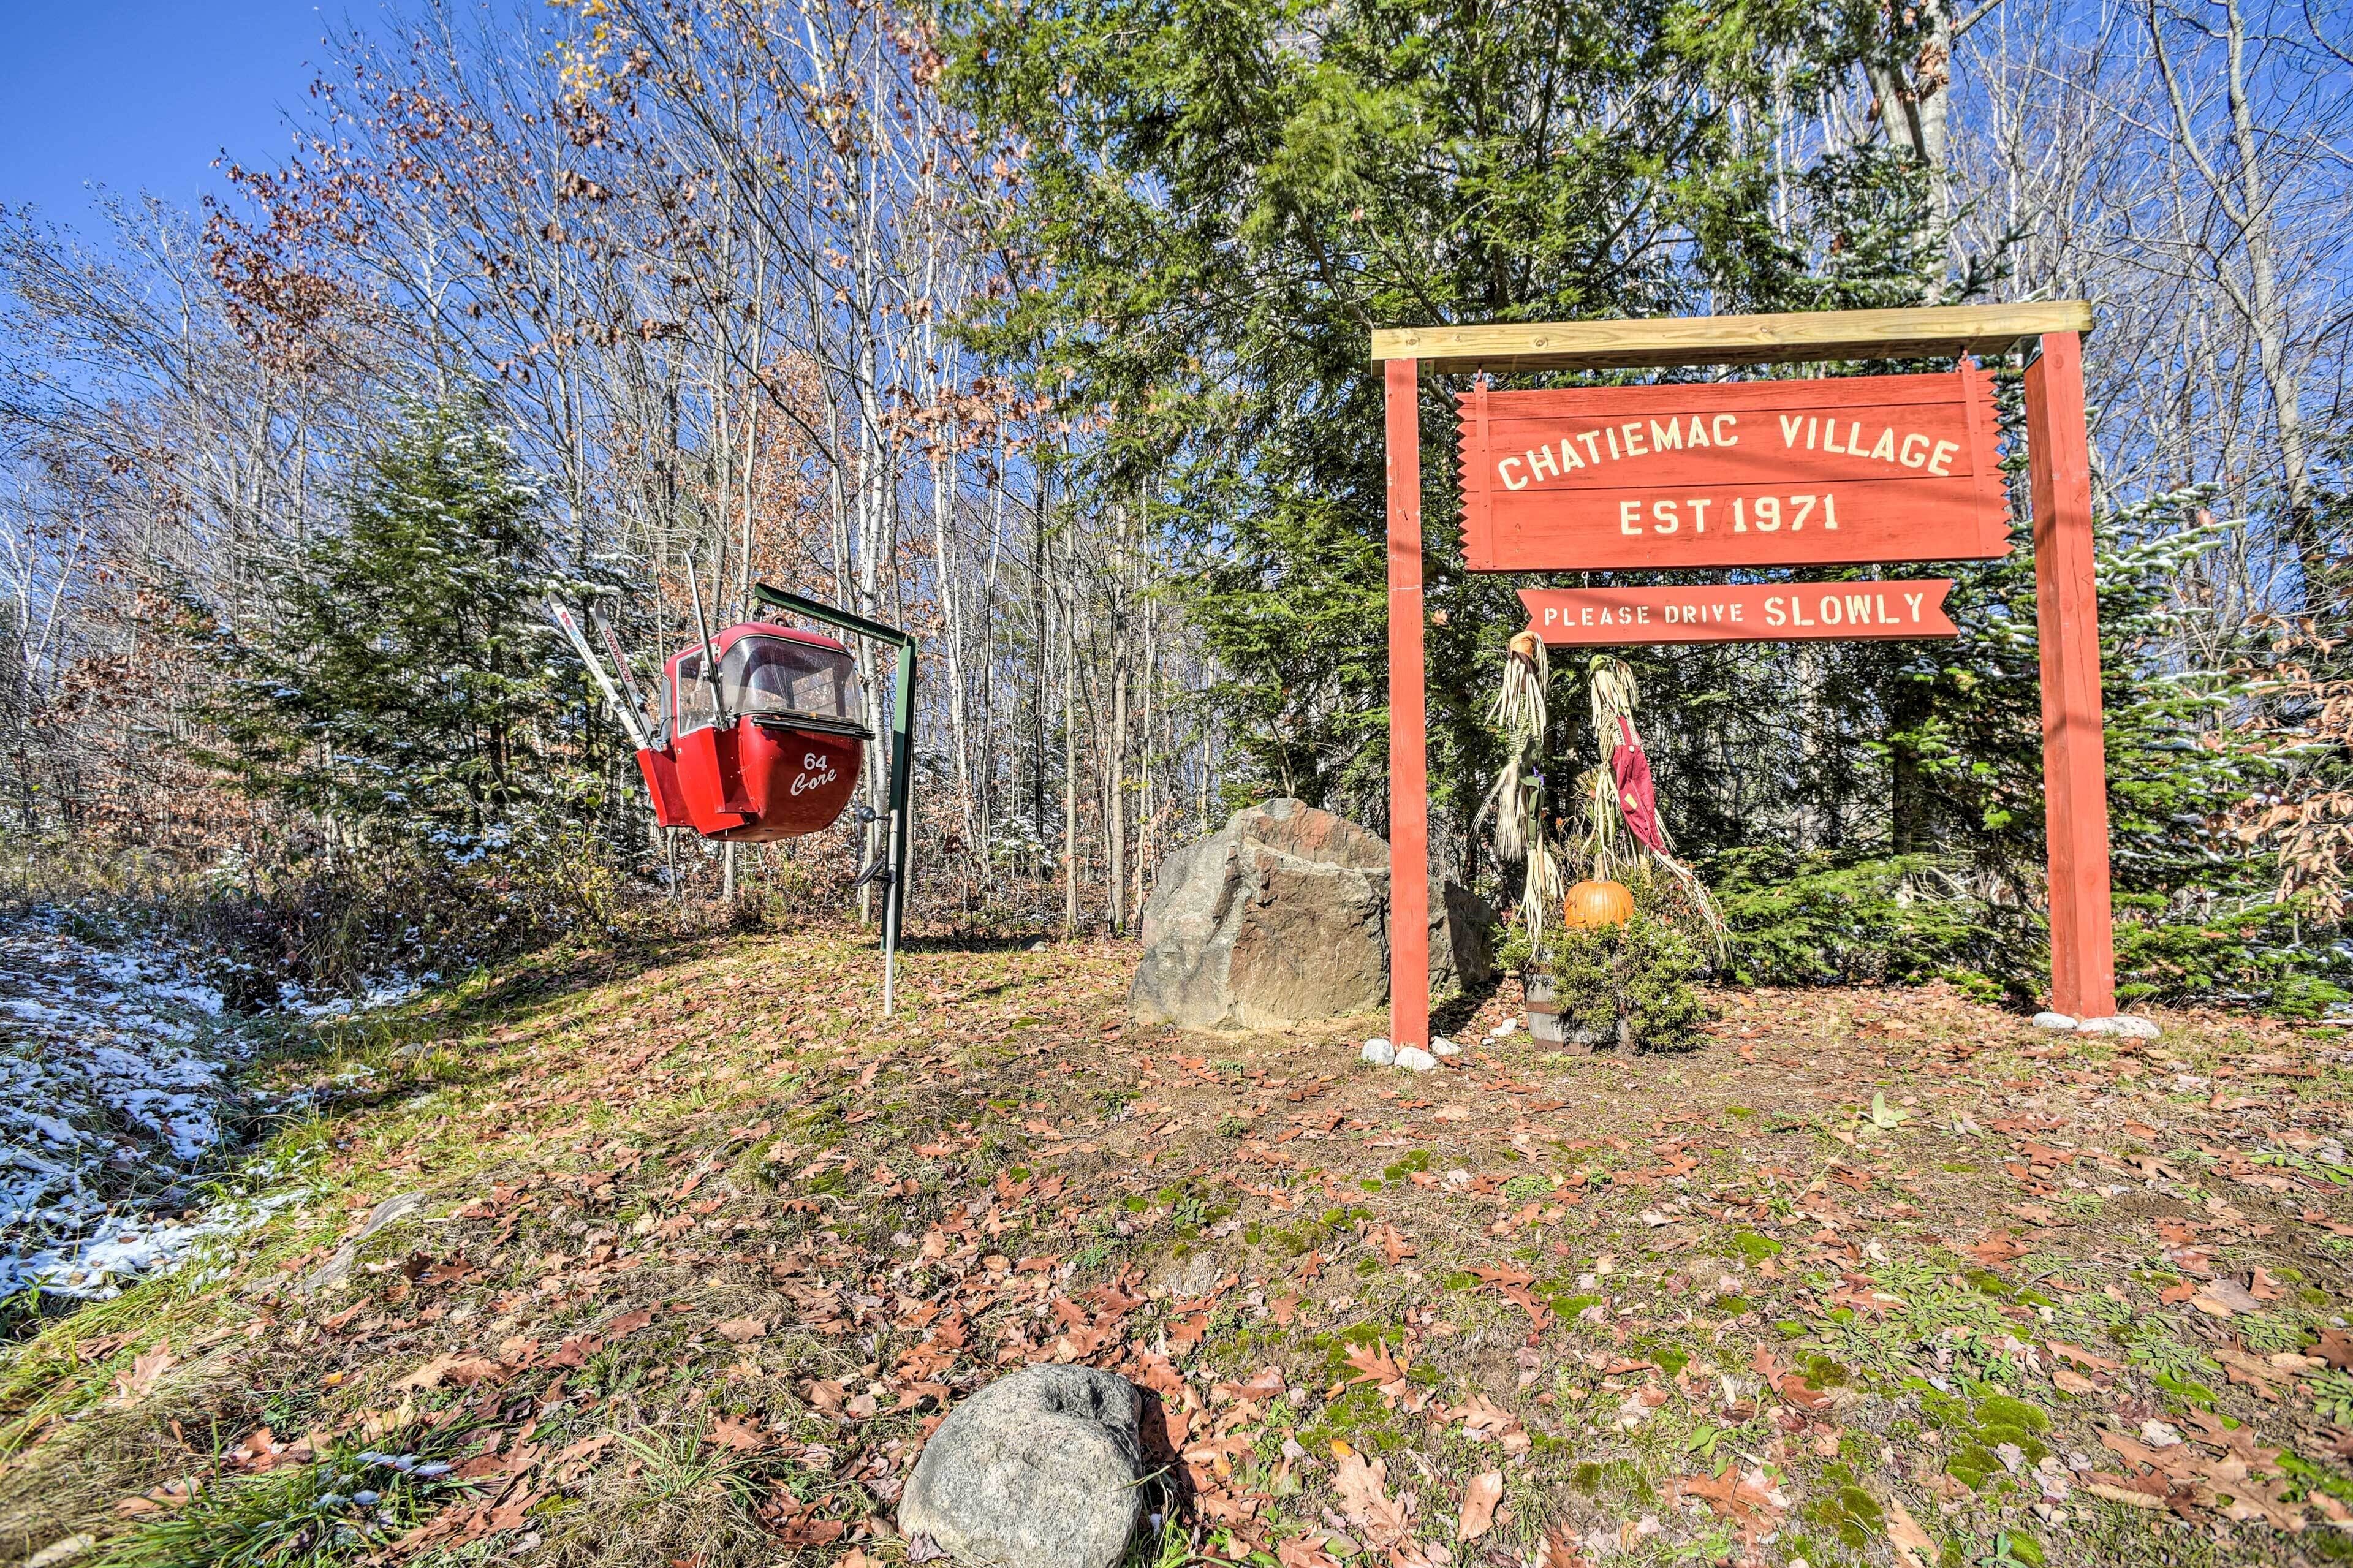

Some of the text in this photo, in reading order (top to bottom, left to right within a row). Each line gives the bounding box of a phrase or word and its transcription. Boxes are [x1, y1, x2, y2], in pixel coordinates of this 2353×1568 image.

[1497, 413, 1960, 491] CHATIEMAC VILLAGE
[1619, 493, 1839, 536] EST 1971
[1544, 592, 1924, 627] PLEASE DRIVE SLOWLY
[603, 626, 632, 683] ROSSIGNOL
[803, 752, 827, 771] 64
[790, 768, 837, 796] Gore
